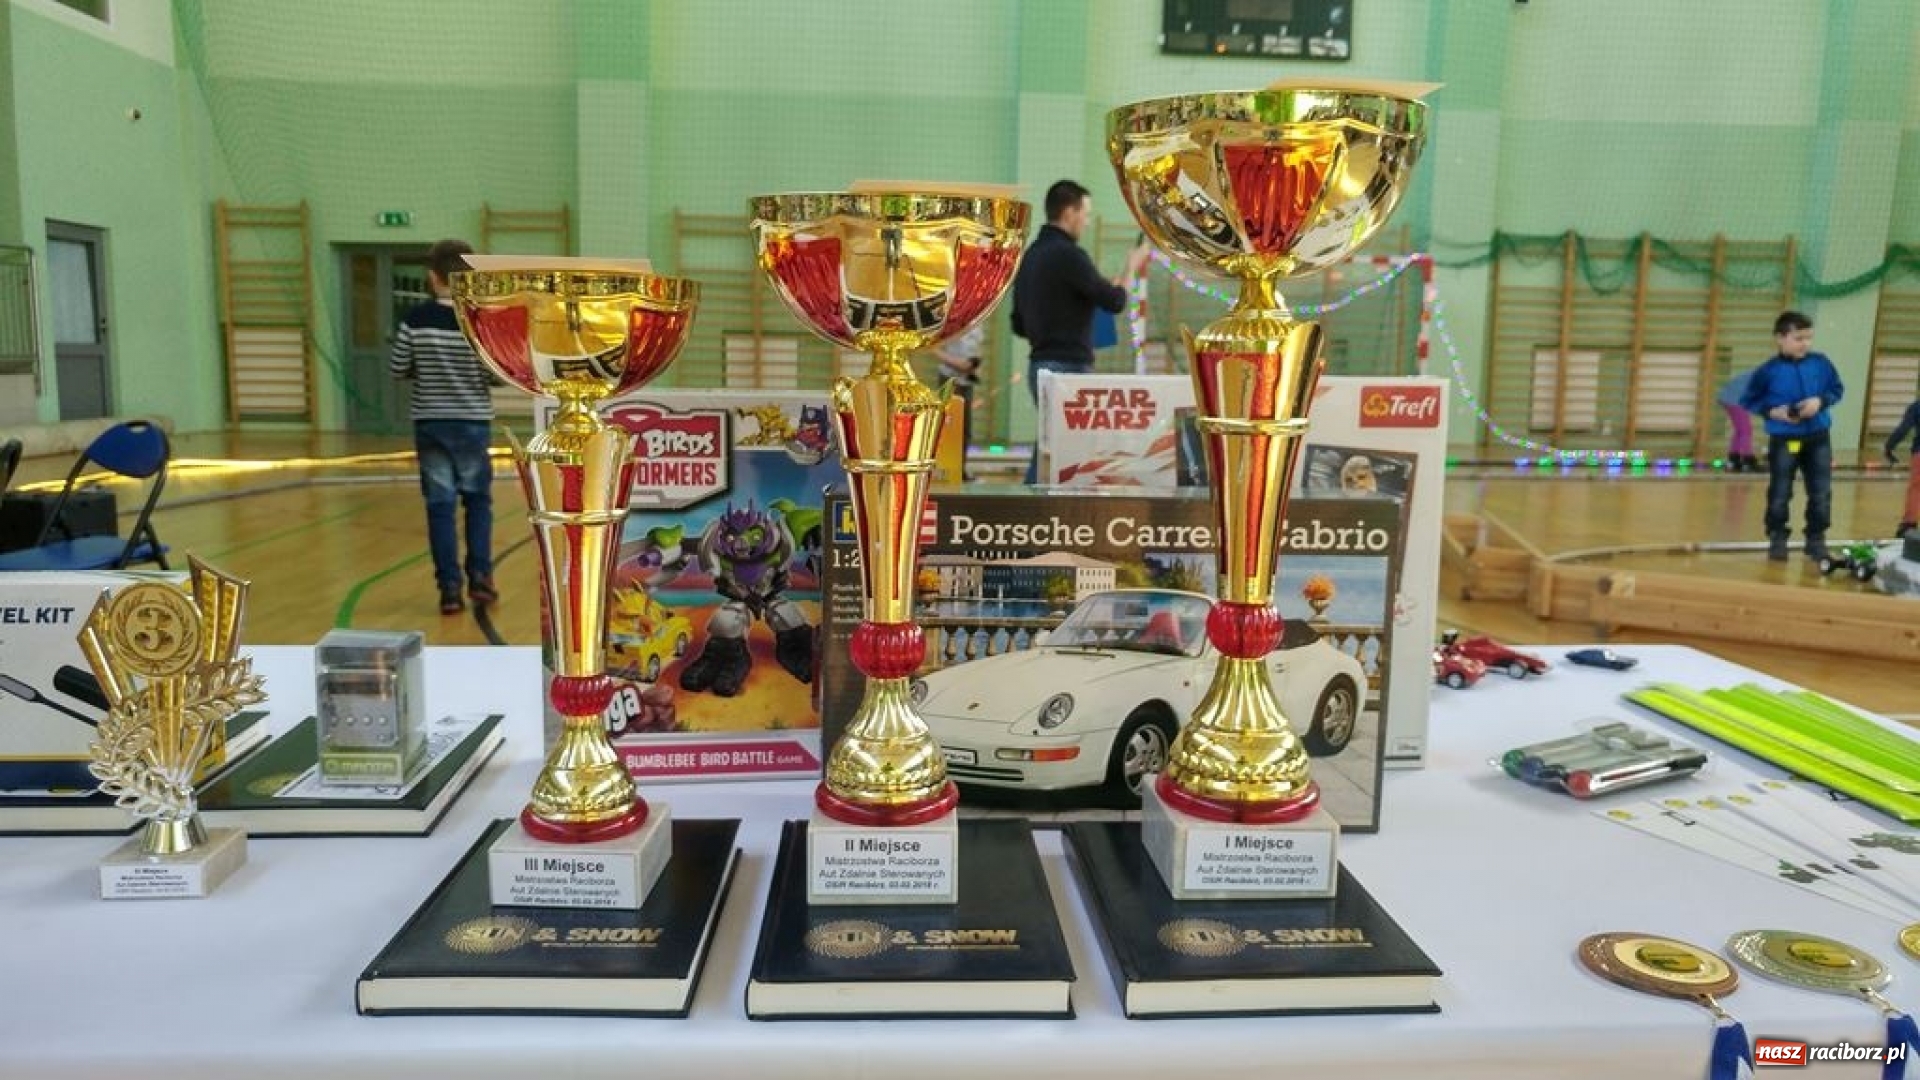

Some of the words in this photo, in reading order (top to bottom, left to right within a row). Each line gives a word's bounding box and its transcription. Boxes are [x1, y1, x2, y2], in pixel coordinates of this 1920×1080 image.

[1064, 388, 1155, 408] STAR
[1390, 395, 1437, 419] Trefl
[1064, 410, 1155, 430] WARS
[642, 429, 715, 458] BIRDS
[637, 462, 717, 486] ORMERS
[950, 516, 1095, 547] Porsche
[1106, 517, 1221, 548] Carre
[832, 549, 861, 567] 1:2
[0, 607, 31, 623] EL
[35, 607, 75, 623] KIT
[135, 606, 174, 651] 3
[626, 753, 696, 769] BUMBLEBEE
[700, 752, 730, 767] BIRD
[732, 751, 774, 766] BATTLE
[845, 839, 854, 852] II
[859, 839, 921, 855] Miejsce
[1225, 836, 1230, 848] I
[1235, 836, 1294, 851] Miejsce
[524, 858, 538, 871] III
[543, 858, 605, 874] Miejsce
[888, 857, 940, 866] Raciborza
[819, 869, 836, 878] Aut
[839, 869, 877, 878] Zdalnie
[880, 869, 946, 880] Sterowanych
[1196, 865, 1213, 874] Aut
[1216, 865, 1252, 874] Zdalnie
[1255, 865, 1319, 876] Sterowanych
[531, 928, 557, 940] &
[567, 928, 665, 941] SNOW
[892, 930, 917, 944] &
[925, 930, 1018, 944] SNOW
[1244, 929, 1270, 942] &
[1273, 928, 1364, 942] SNOW
